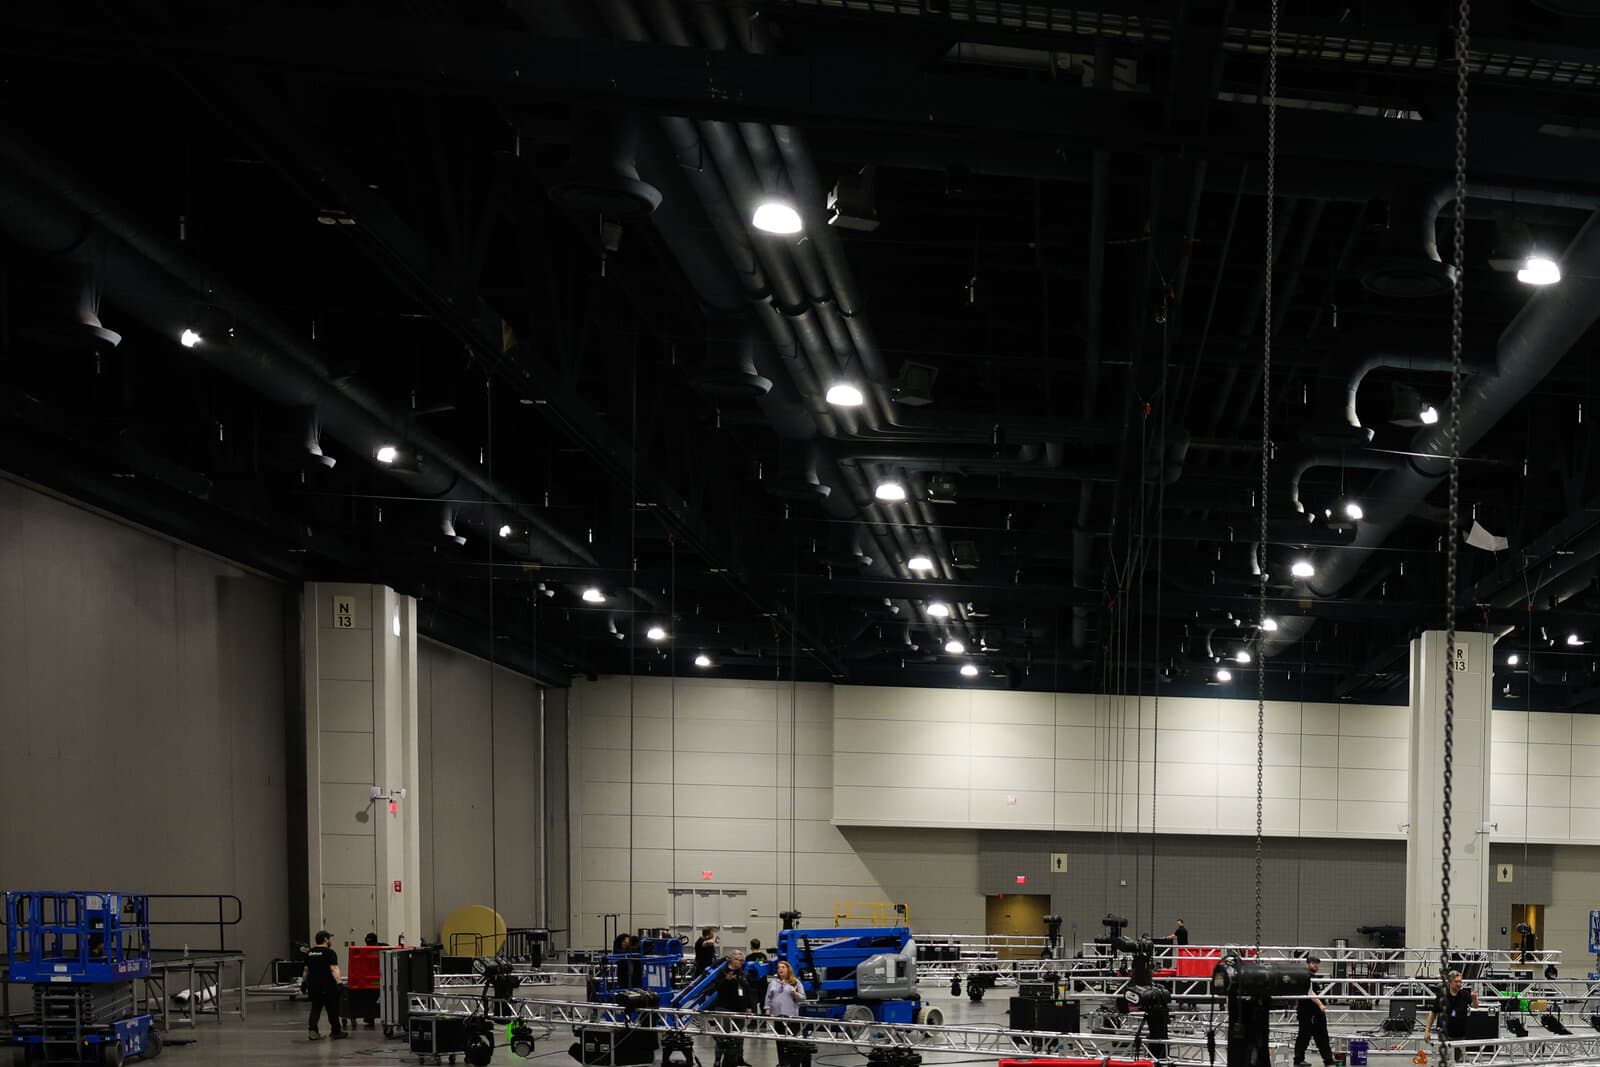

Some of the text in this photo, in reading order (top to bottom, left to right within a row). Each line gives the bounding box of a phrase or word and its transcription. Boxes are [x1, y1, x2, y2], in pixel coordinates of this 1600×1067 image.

[339, 603, 349, 613] N
[338, 616, 352, 627] 13
[1456, 648, 1463, 659] R
[1454, 661, 1466, 671] 13
